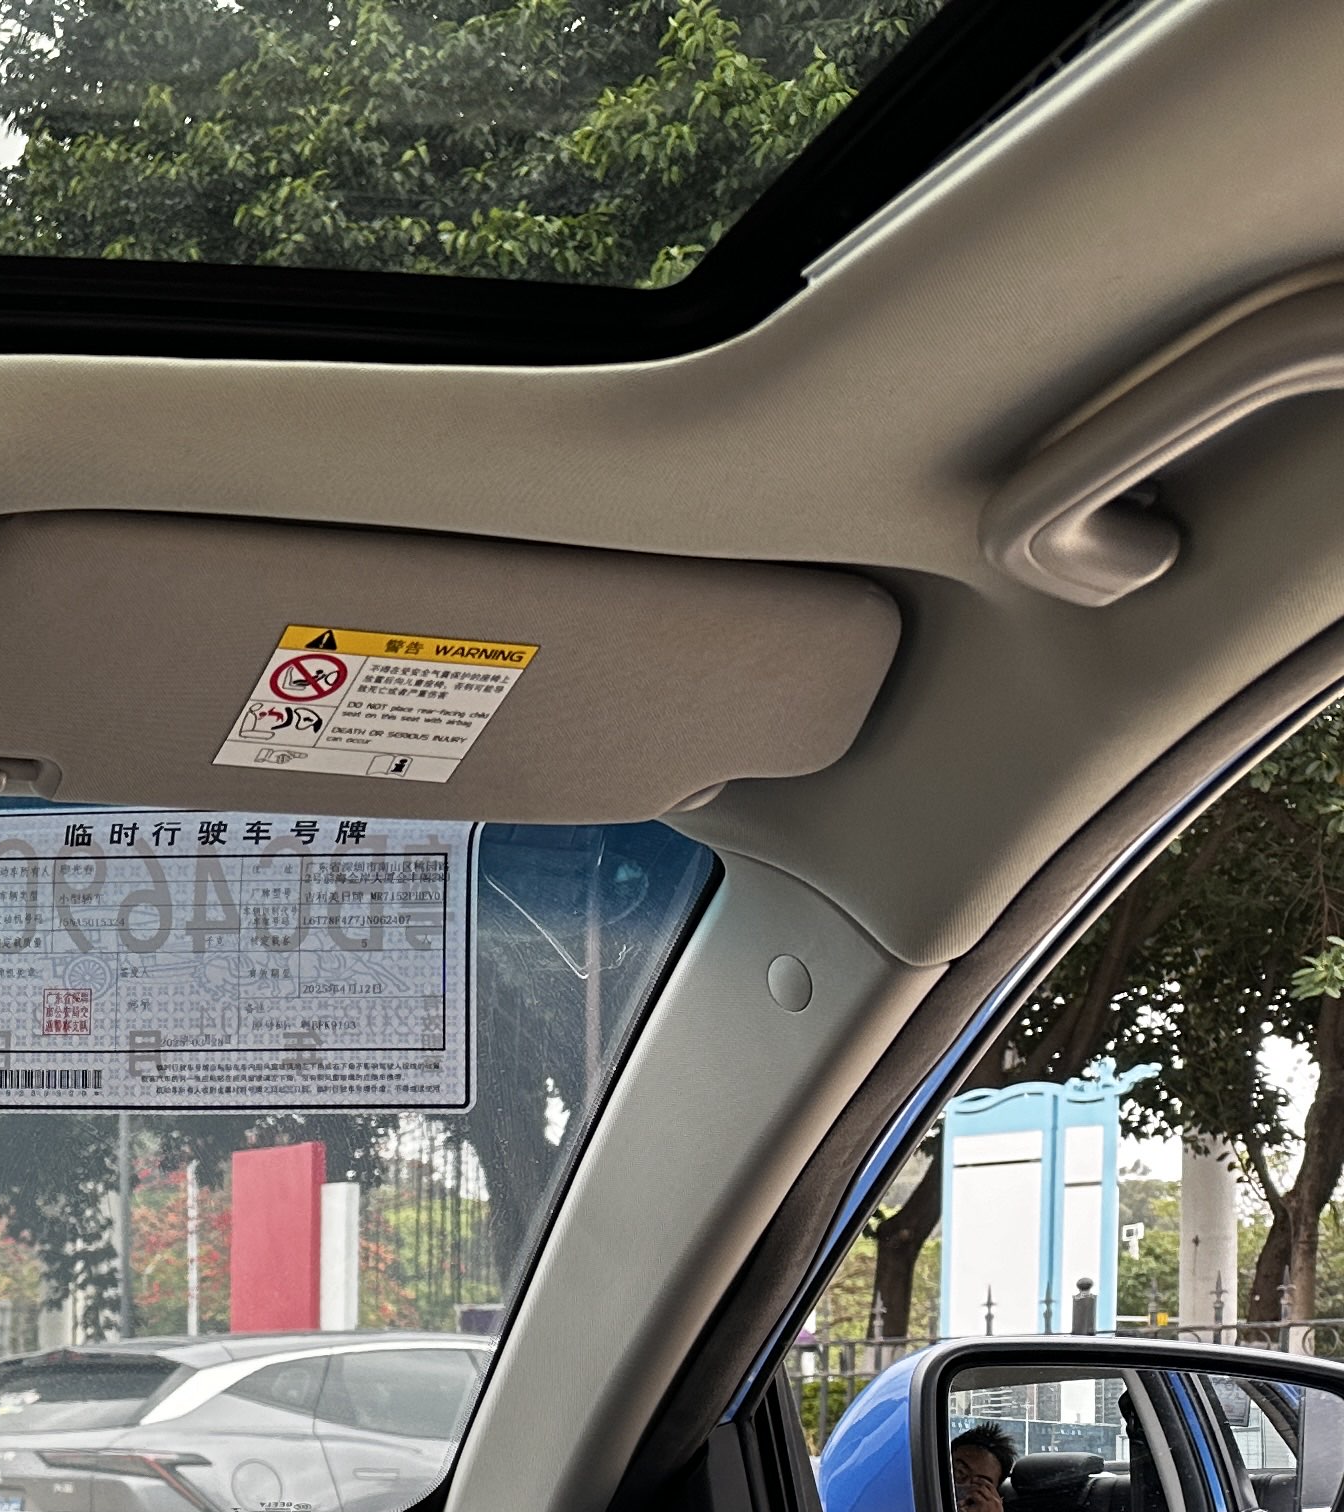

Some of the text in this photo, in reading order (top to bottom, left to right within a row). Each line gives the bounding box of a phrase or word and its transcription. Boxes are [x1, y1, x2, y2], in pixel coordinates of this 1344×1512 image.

[384, 639, 527, 663] 警告 WARNING
[347, 701, 490, 719] DO NOT place rear-facing child
[445, 719, 473, 728] airbag
[331, 727, 468, 744] DEATH OR SERIOUS INJURY
[346, 737, 372, 745] occur
[64, 820, 369, 848] 临时行驶车号牌
